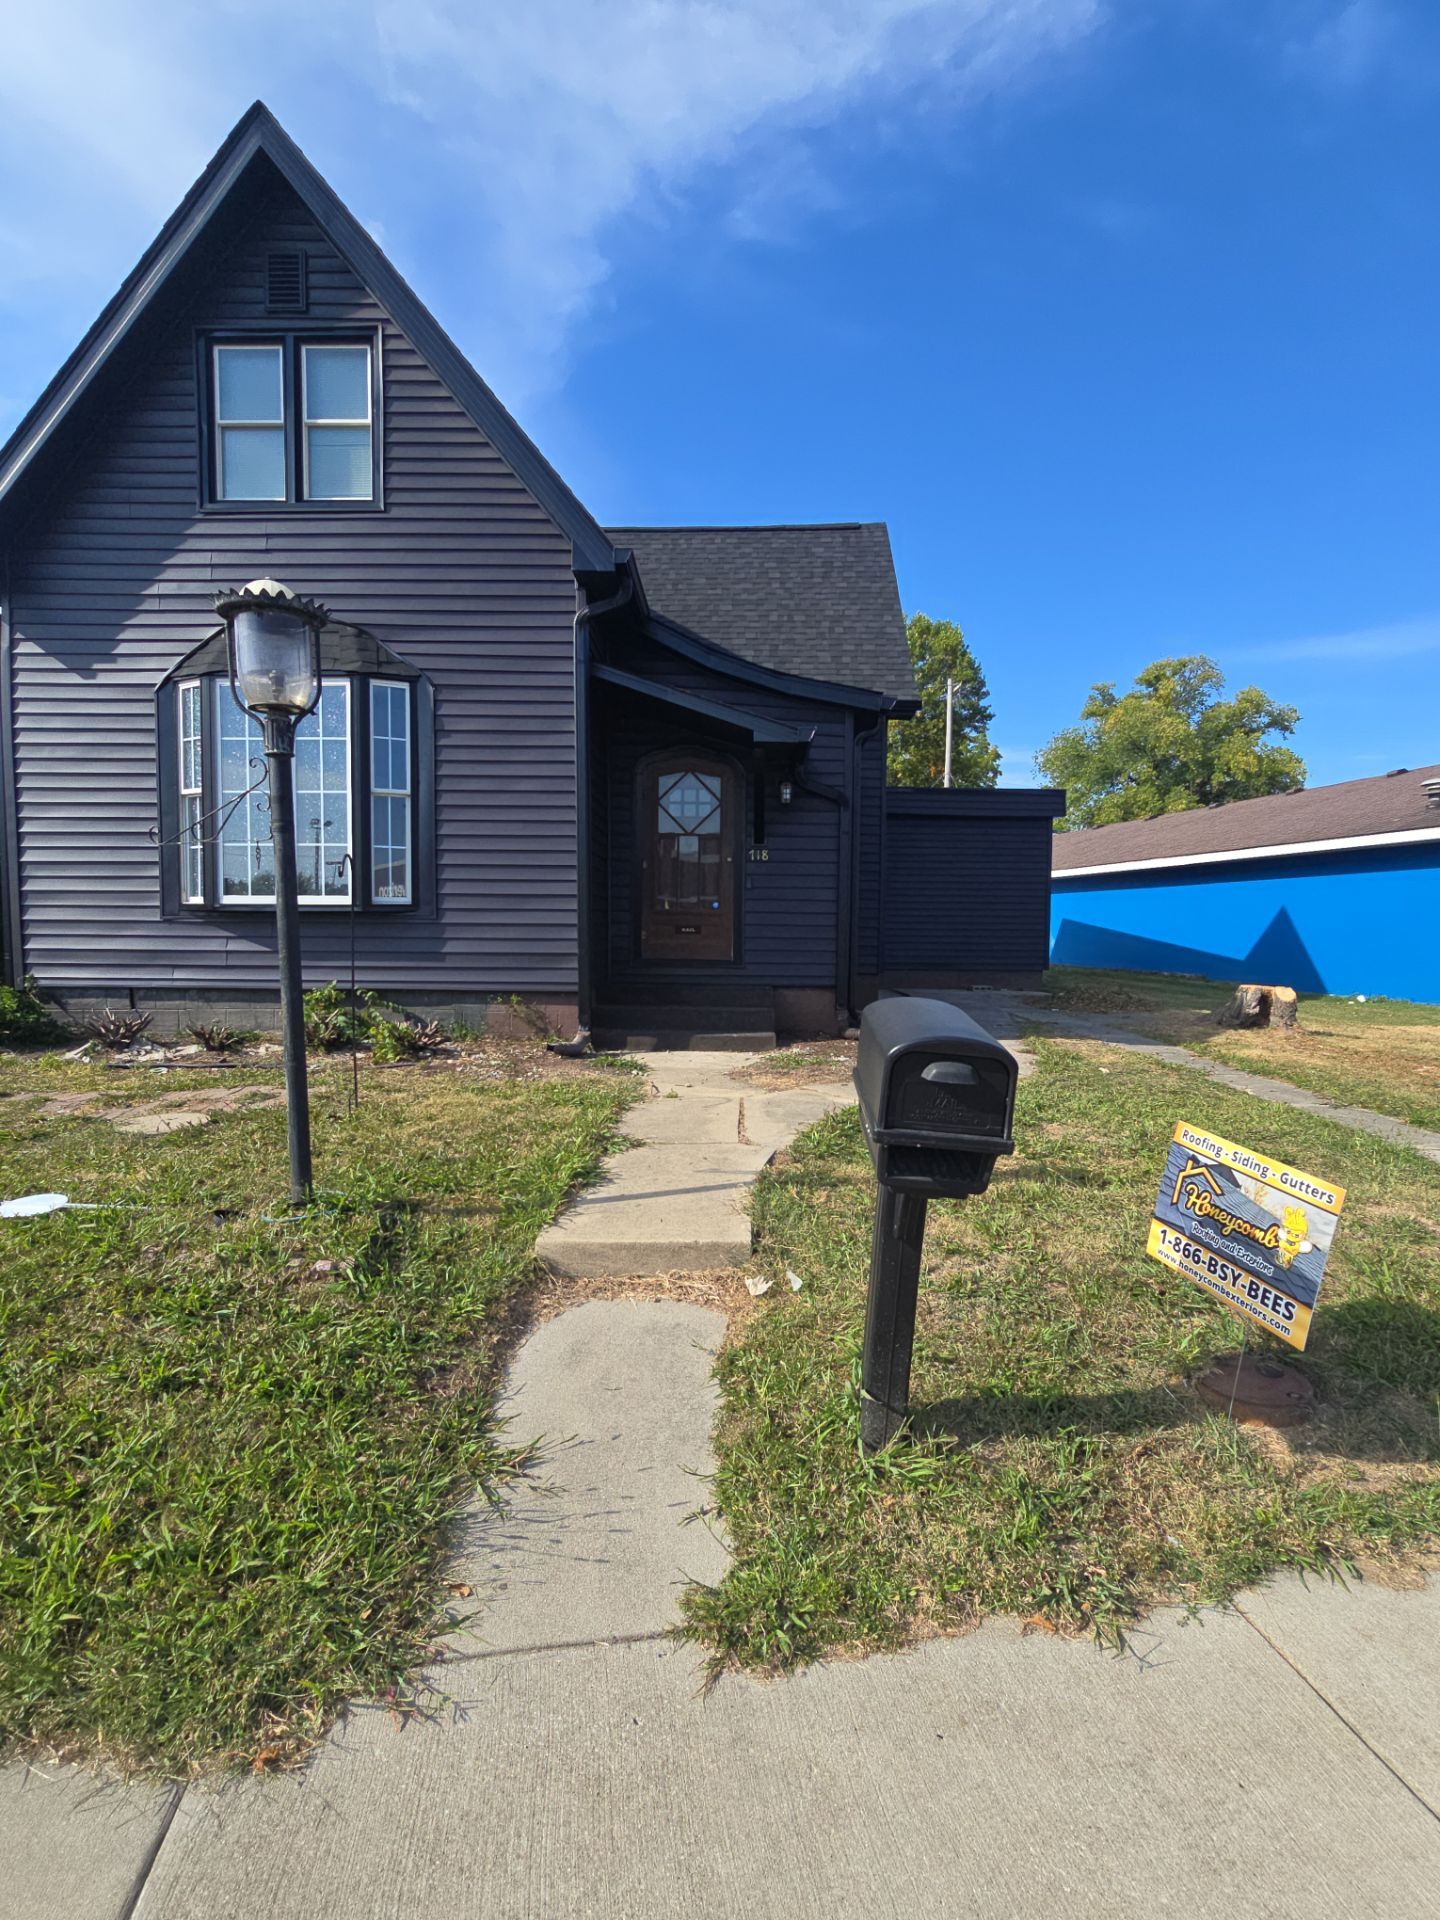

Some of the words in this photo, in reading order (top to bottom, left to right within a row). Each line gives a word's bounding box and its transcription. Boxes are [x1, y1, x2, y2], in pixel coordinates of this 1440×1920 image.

[1182, 1129, 1223, 1158] Roofing
[1231, 1151, 1270, 1179] Siding
[1280, 1172, 1334, 1204] Gutters
[1185, 1182, 1279, 1248] Honeycomb
[1192, 1222, 1220, 1247] Roofing
[1221, 1240, 1236, 1254] and
[1236, 1247, 1273, 1276] Exteriors
[1157, 1248, 1291, 1336] www.honeycombexteriors.com
[1160, 1229, 1296, 1321] 1-866-BSY-BEES
